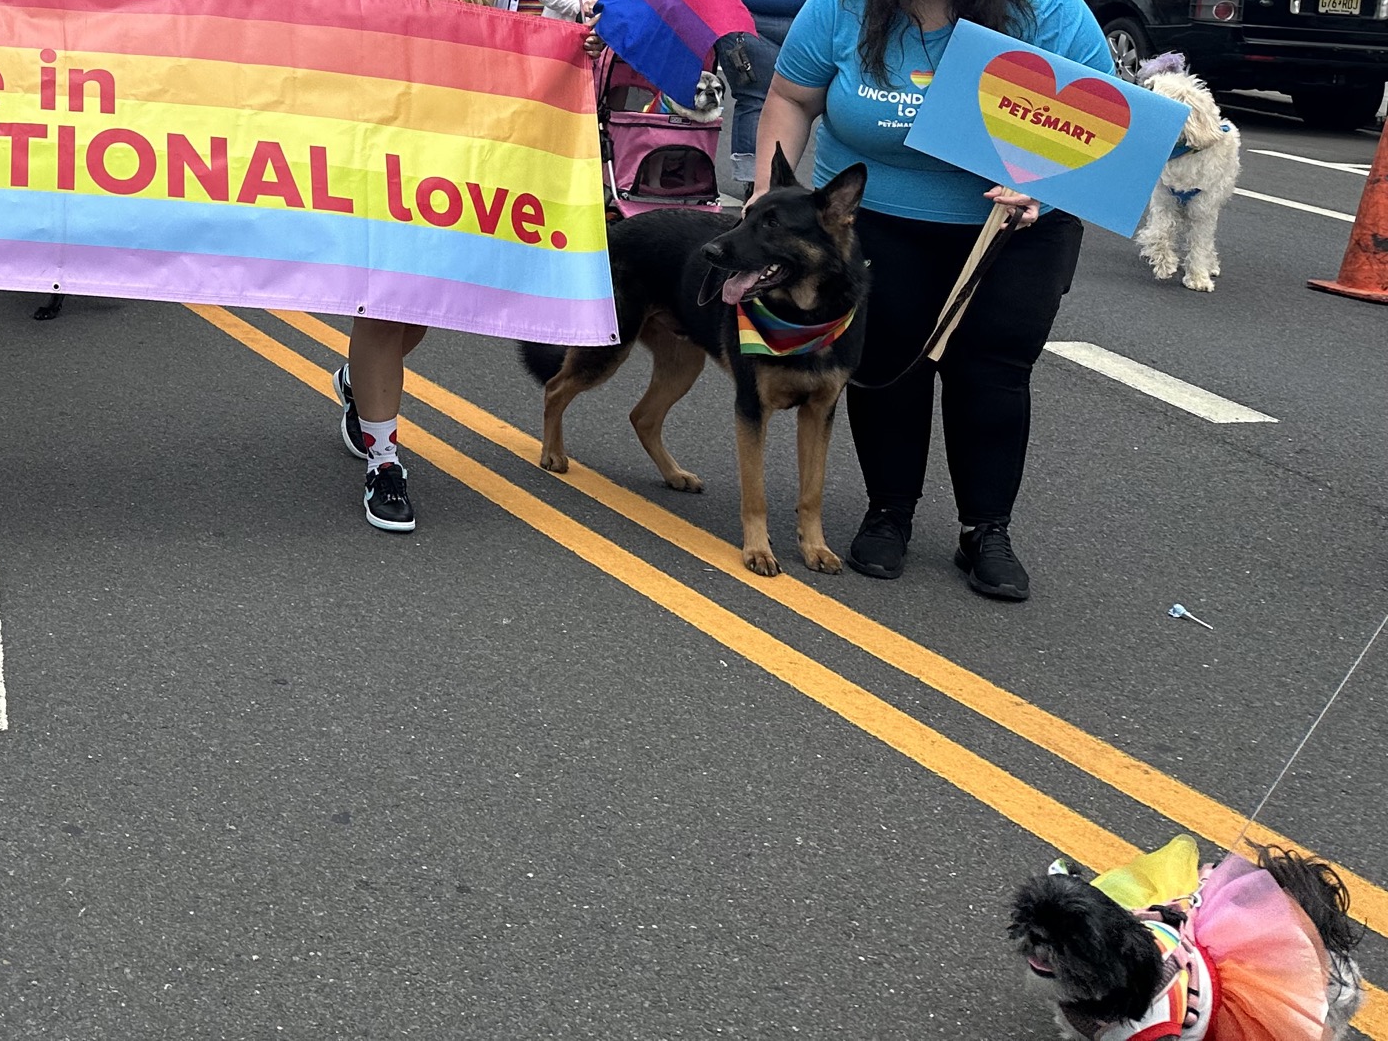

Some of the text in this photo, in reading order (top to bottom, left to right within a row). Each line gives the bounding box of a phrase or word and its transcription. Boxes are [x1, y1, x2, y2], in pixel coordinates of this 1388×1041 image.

[39, 48, 115, 115] in
[858, 84, 924, 105] UNCOND
[998, 95, 1096, 146] PETSMART
[385, 153, 569, 250] love.
